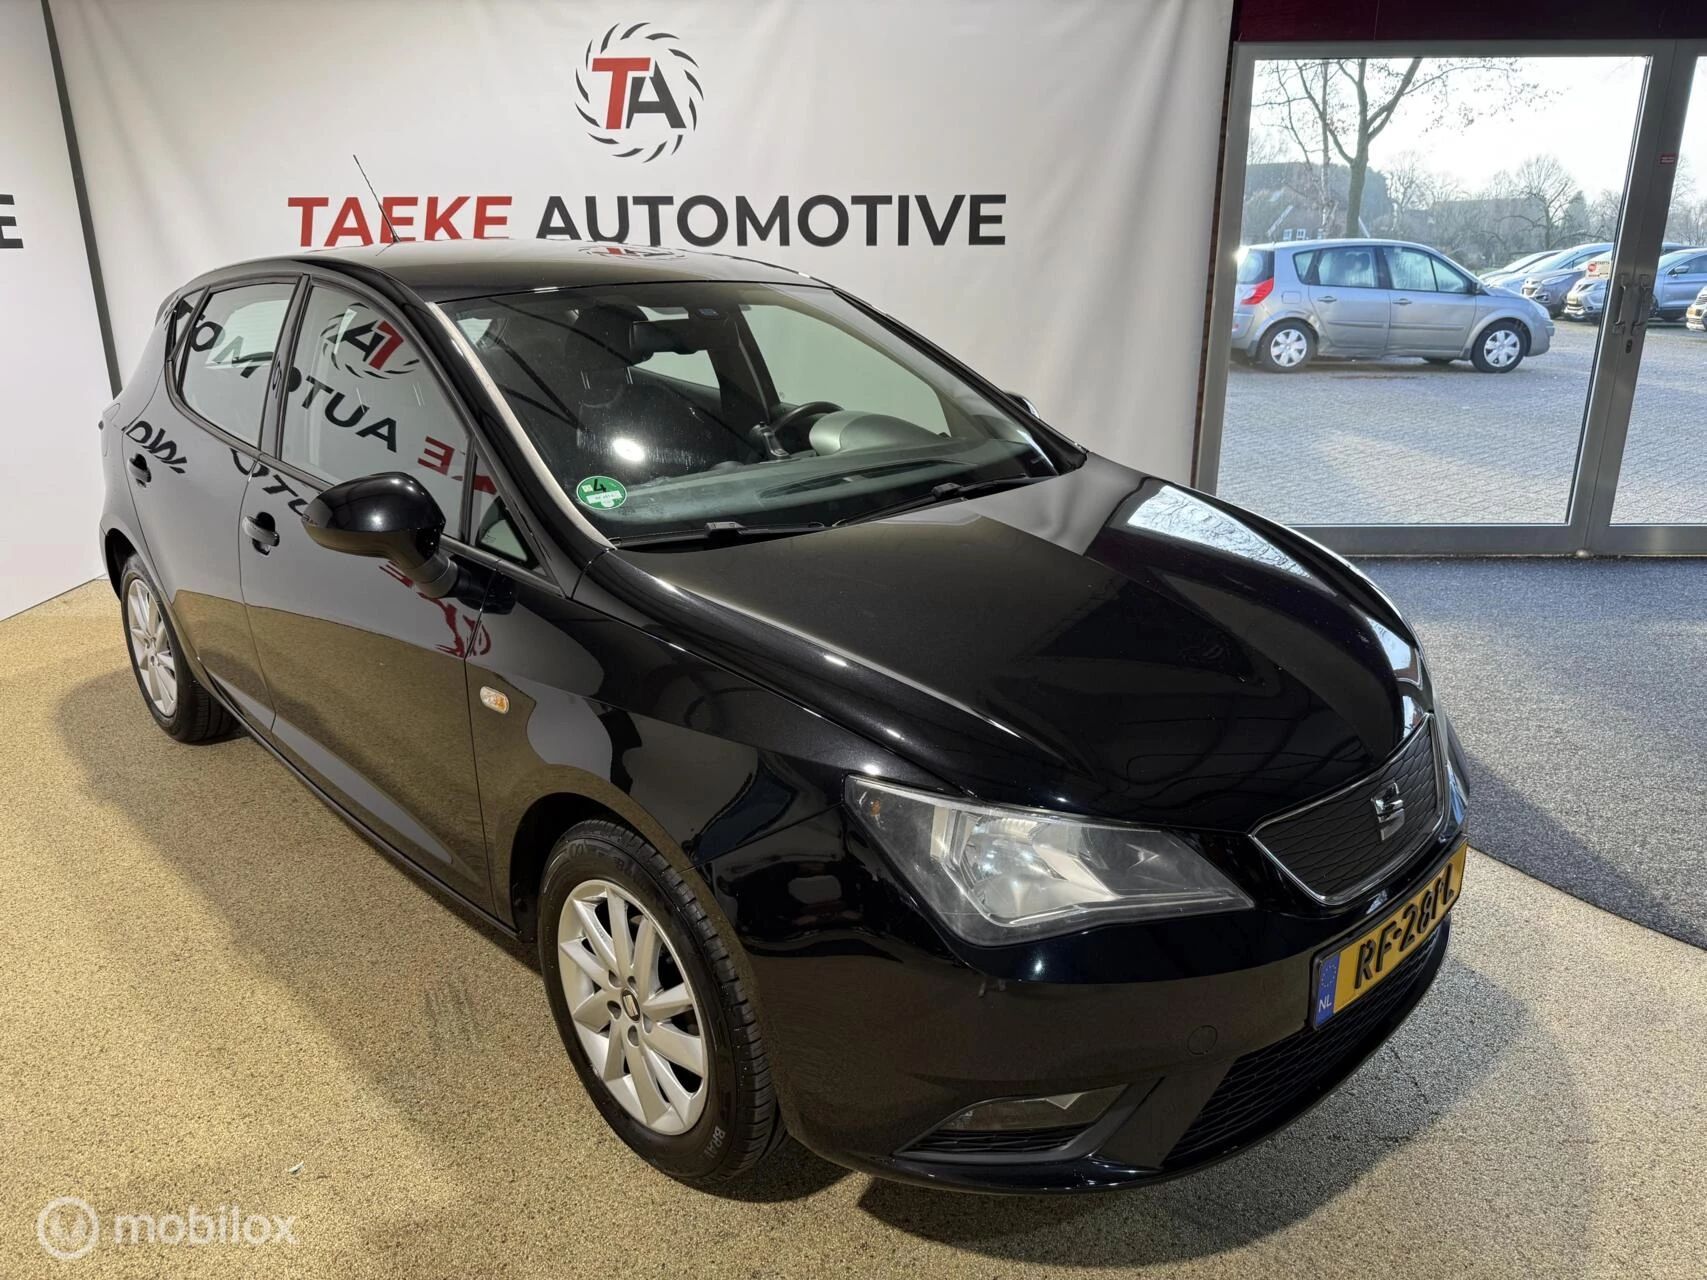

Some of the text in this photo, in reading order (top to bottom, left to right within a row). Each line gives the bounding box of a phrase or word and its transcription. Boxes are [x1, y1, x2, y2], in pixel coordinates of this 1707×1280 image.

[591, 57, 687, 130] TA
[288, 194, 1007, 247] TAEKE AUTOMOTIVE
[1318, 995, 1333, 1012] NL
